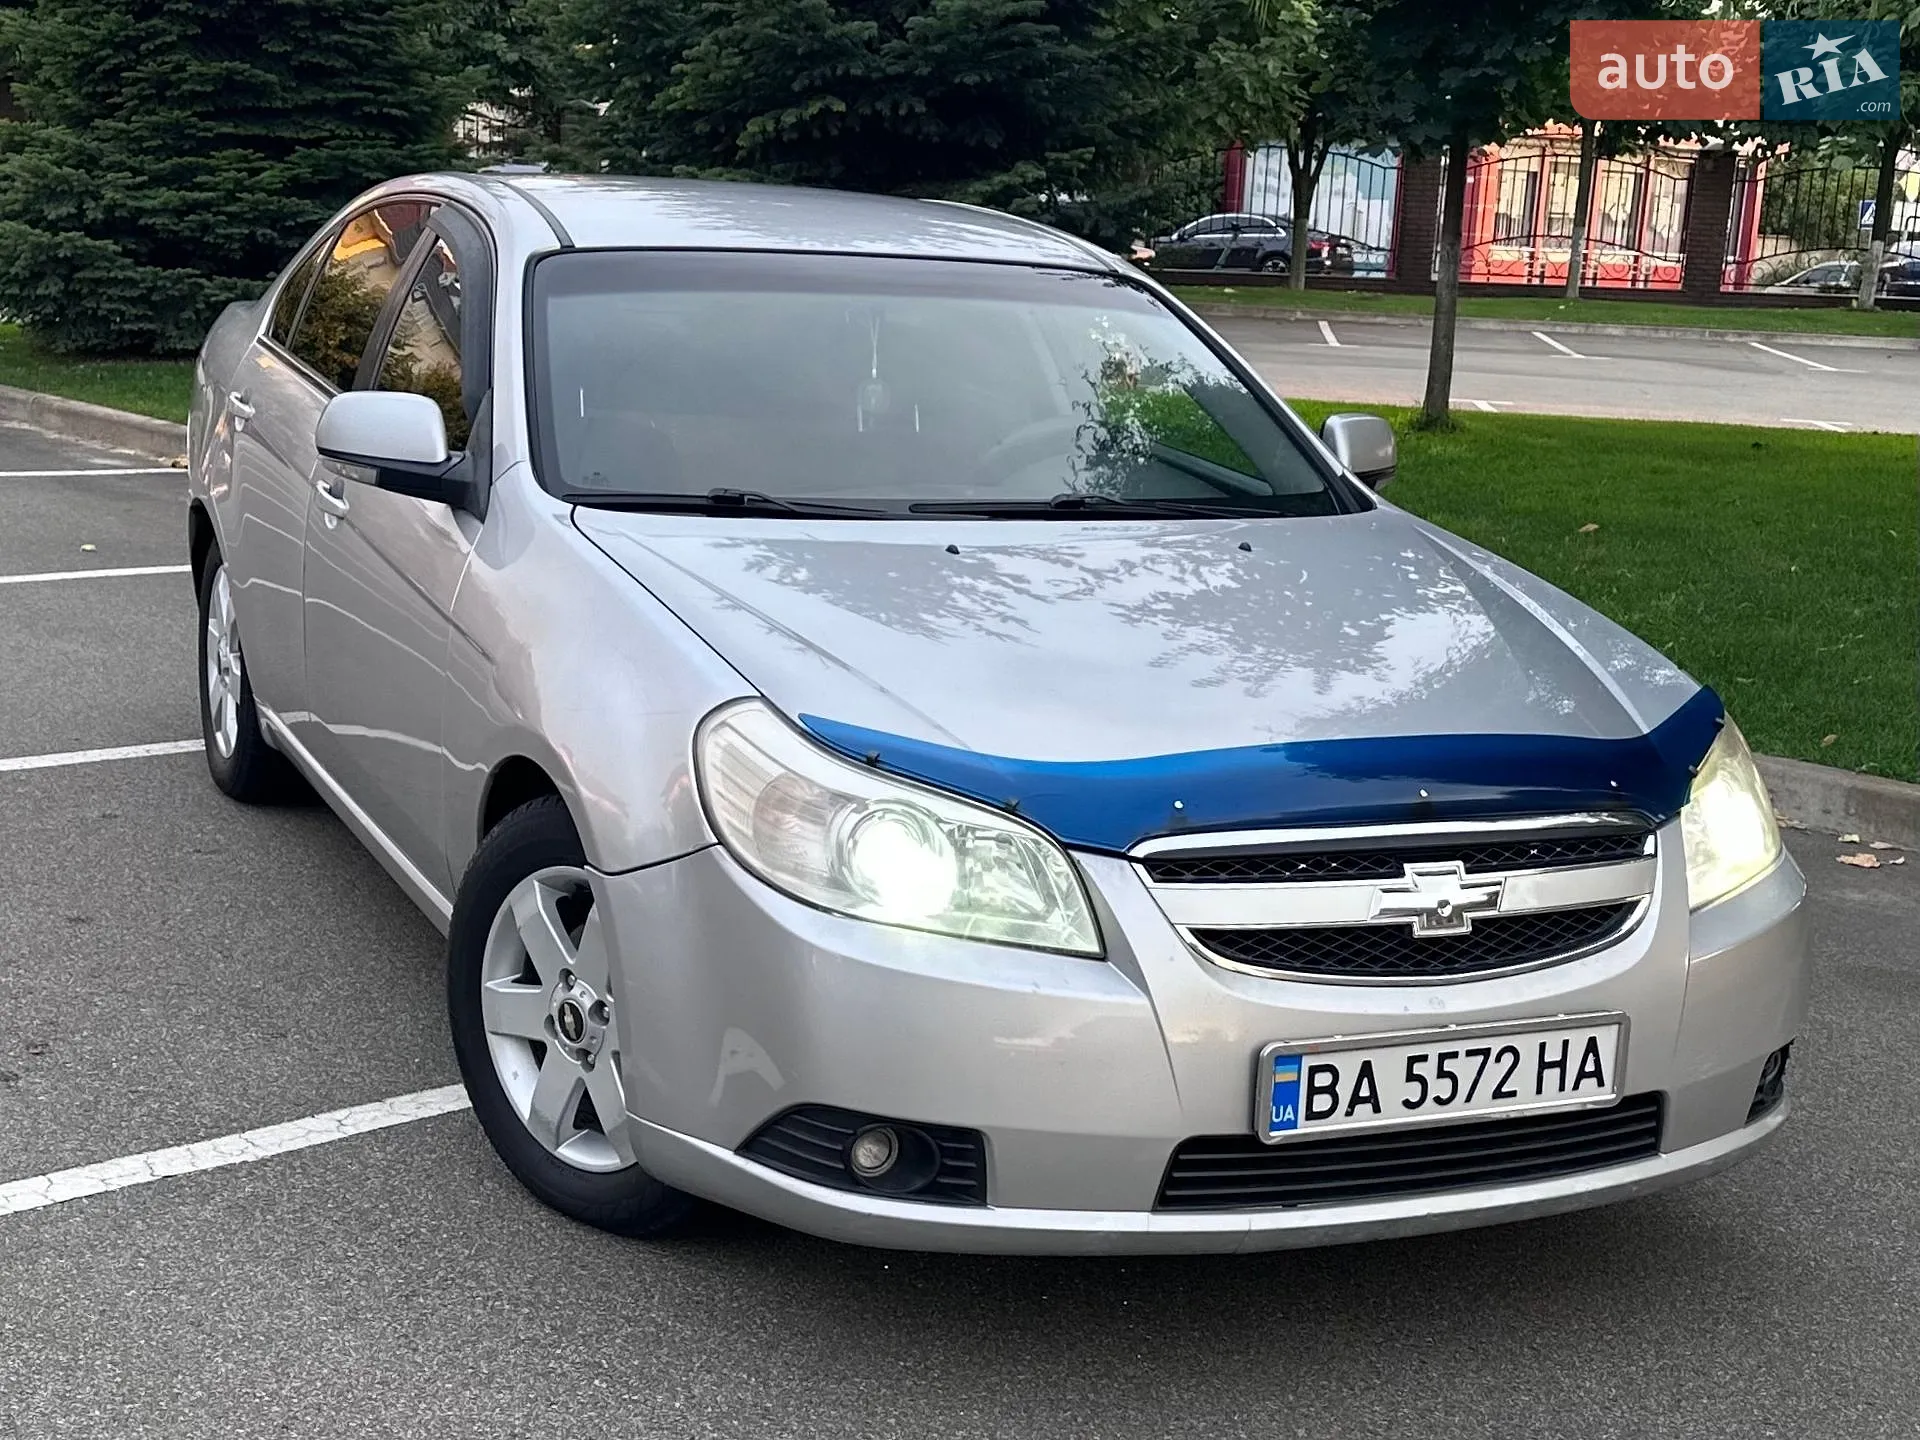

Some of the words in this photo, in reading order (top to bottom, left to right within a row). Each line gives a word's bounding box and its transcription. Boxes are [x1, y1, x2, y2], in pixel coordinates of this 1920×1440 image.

[1304, 1059, 1382, 1121] BA
[1401, 1045, 1521, 1110] 5572
[1535, 1035, 1606, 1095] HA
[1271, 1104, 1296, 1123] UA
